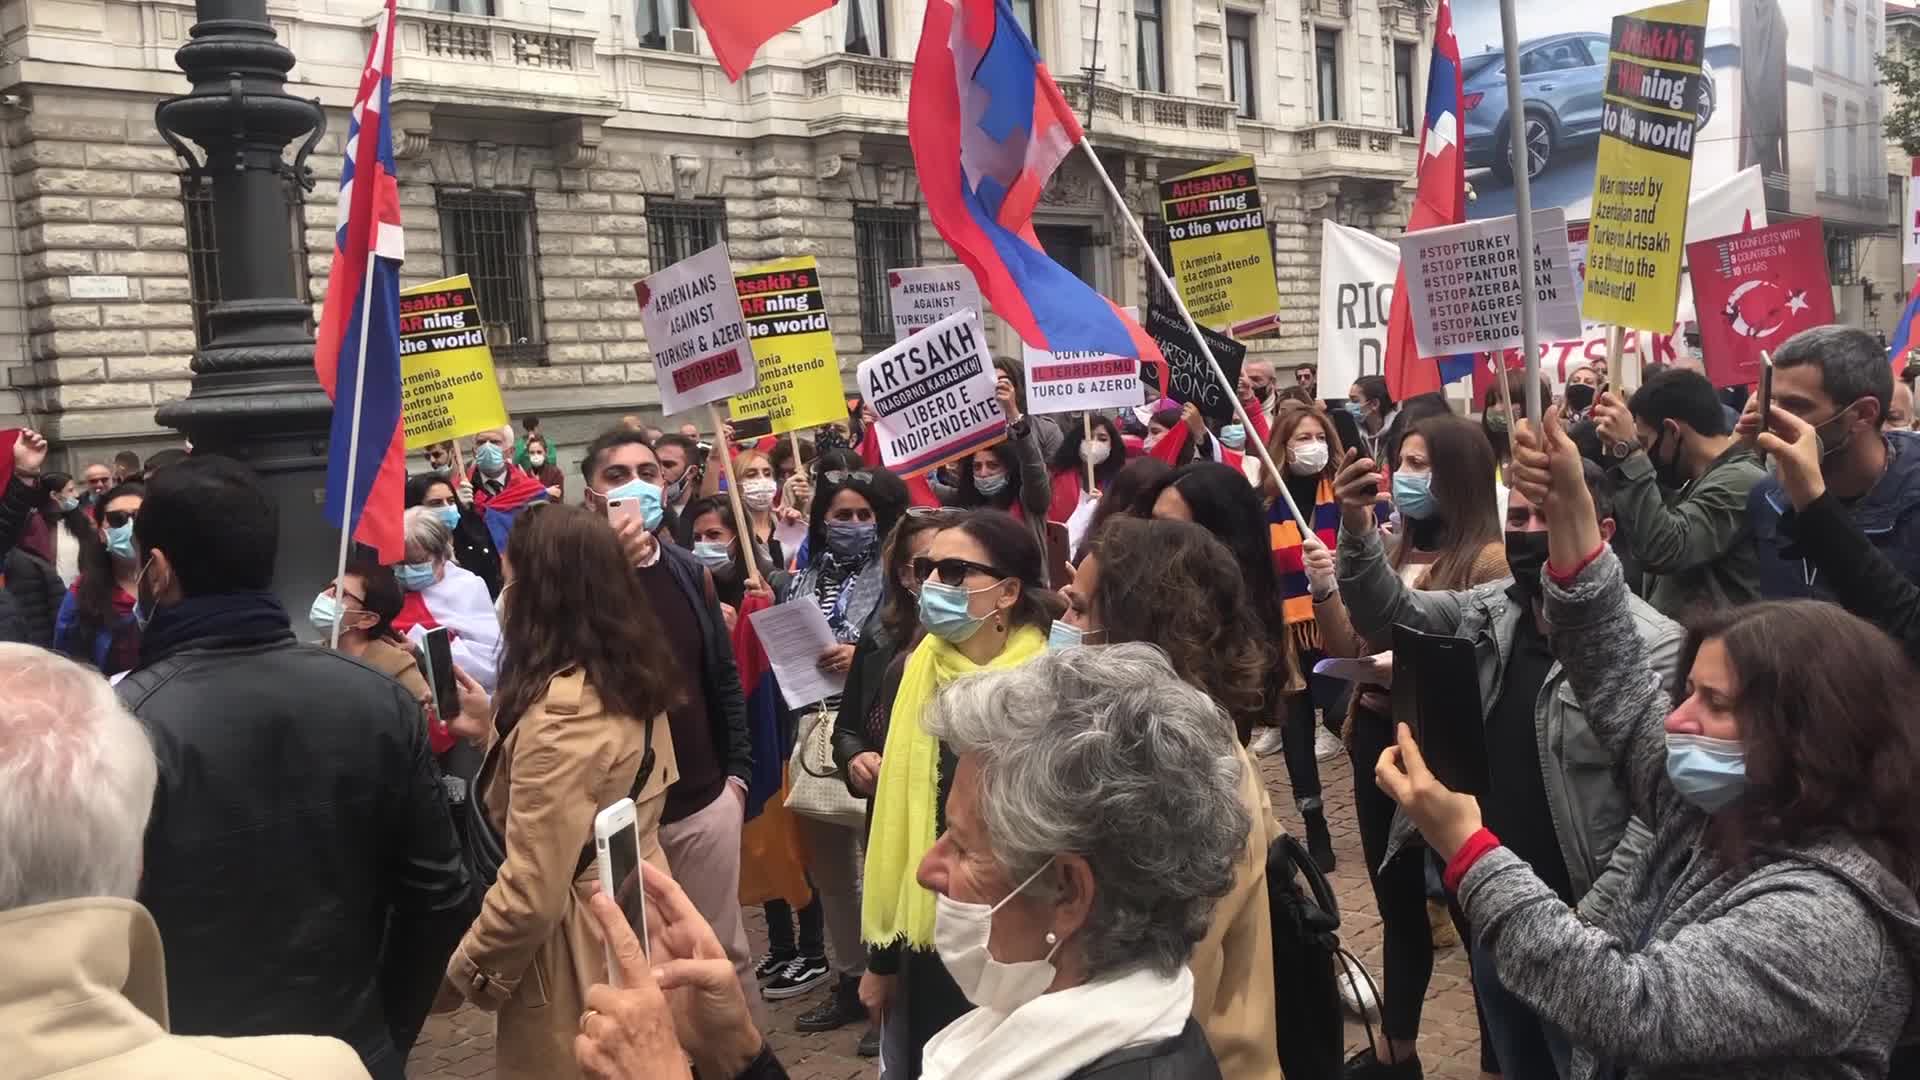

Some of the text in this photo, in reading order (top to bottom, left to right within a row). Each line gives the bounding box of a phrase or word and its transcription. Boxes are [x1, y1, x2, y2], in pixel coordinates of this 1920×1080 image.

[1603, 104, 1617, 131] to
[1639, 119, 1692, 152] world
[1172, 174, 1248, 197] Artsakh's
[1648, 177, 1663, 202] by
[1176, 193, 1246, 217] WARning
[1634, 204, 1656, 224] and
[1169, 212, 1261, 239] to the world
[1420, 234, 1511, 259] #STOPTURKEY
[1625, 230, 1670, 253] Artsakh
[1729, 241, 1739, 251] 31
[1198, 254, 1260, 279] combattendo
[1422, 243, 1541, 273] #STOPTERRORIM
[1625, 256, 1634, 275] to
[1637, 257, 1656, 278] the
[737, 274, 809, 293] tsakh's
[1214, 276, 1232, 287] una
[1424, 258, 1553, 288] #STOPPANTURSM
[655, 274, 717, 313] ARMENIANS
[904, 281, 960, 294] ARMENIANS
[1428, 273, 1552, 304] #STOPAZERBAAN
[741, 293, 809, 314] ARning
[914, 297, 954, 309] AGAINST
[1430, 288, 1557, 318] #STOPAGGRESON
[400, 311, 465, 333] ARning
[671, 303, 715, 336] AGAINST
[747, 313, 826, 337] he world
[896, 314, 936, 325] TURKISH
[1432, 310, 1517, 332] #STOPALIYEV
[432, 330, 483, 349] world
[1434, 325, 1523, 346] #STOPERDOG
[656, 339, 696, 368] TURKISH
[698, 335, 708, 352] &
[869, 323, 976, 397] ARTSAKH
[759, 358, 824, 382] ombattendo
[1048, 361, 1132, 378] TERRORISMO
[412, 370, 483, 396] combattendo
[773, 380, 793, 392] una
[1032, 378, 1137, 398] TURCO & AZERO!
[1146, 361, 1220, 406] SRONG
[403, 391, 454, 412] ontro una
[739, 393, 787, 414] minaccia
[903, 385, 971, 429] LIBERO E
[405, 415, 457, 437] mondiale!
[891, 397, 1000, 457] INDIPENDENTE
